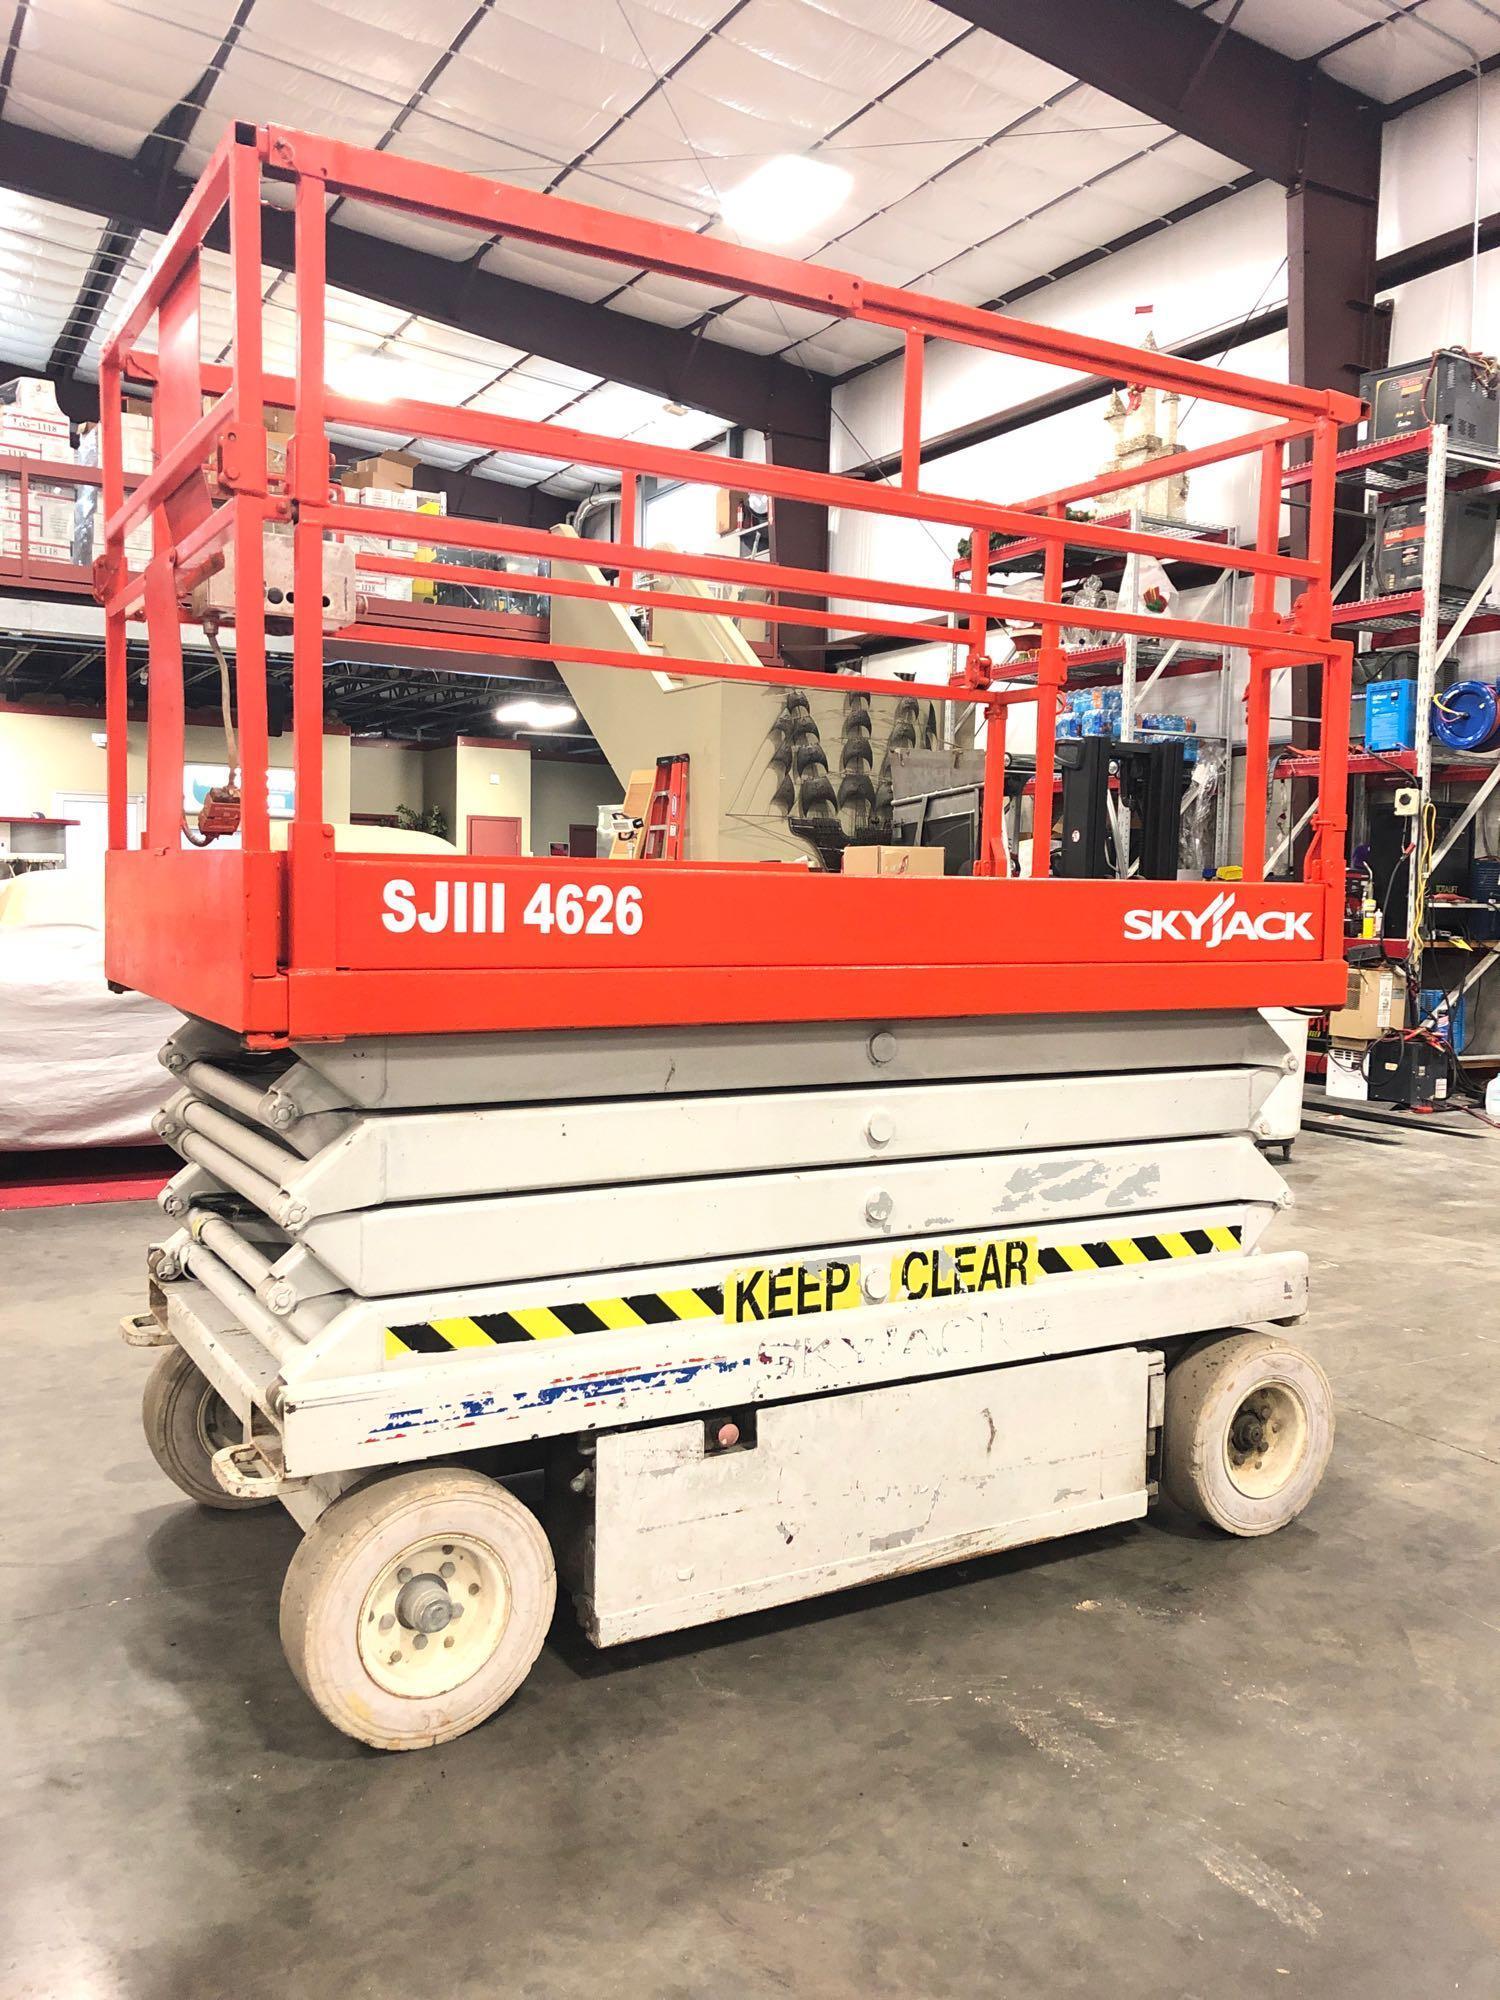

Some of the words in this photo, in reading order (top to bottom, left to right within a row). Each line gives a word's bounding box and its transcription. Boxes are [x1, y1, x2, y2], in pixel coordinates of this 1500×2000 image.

[381, 879, 505, 933] SJIII
[523, 883, 643, 935] 4626
[1124, 891, 1315, 948] SKYJACK
[736, 1260, 851, 1323] KEEP
[902, 1240, 1029, 1300] CLEAR
